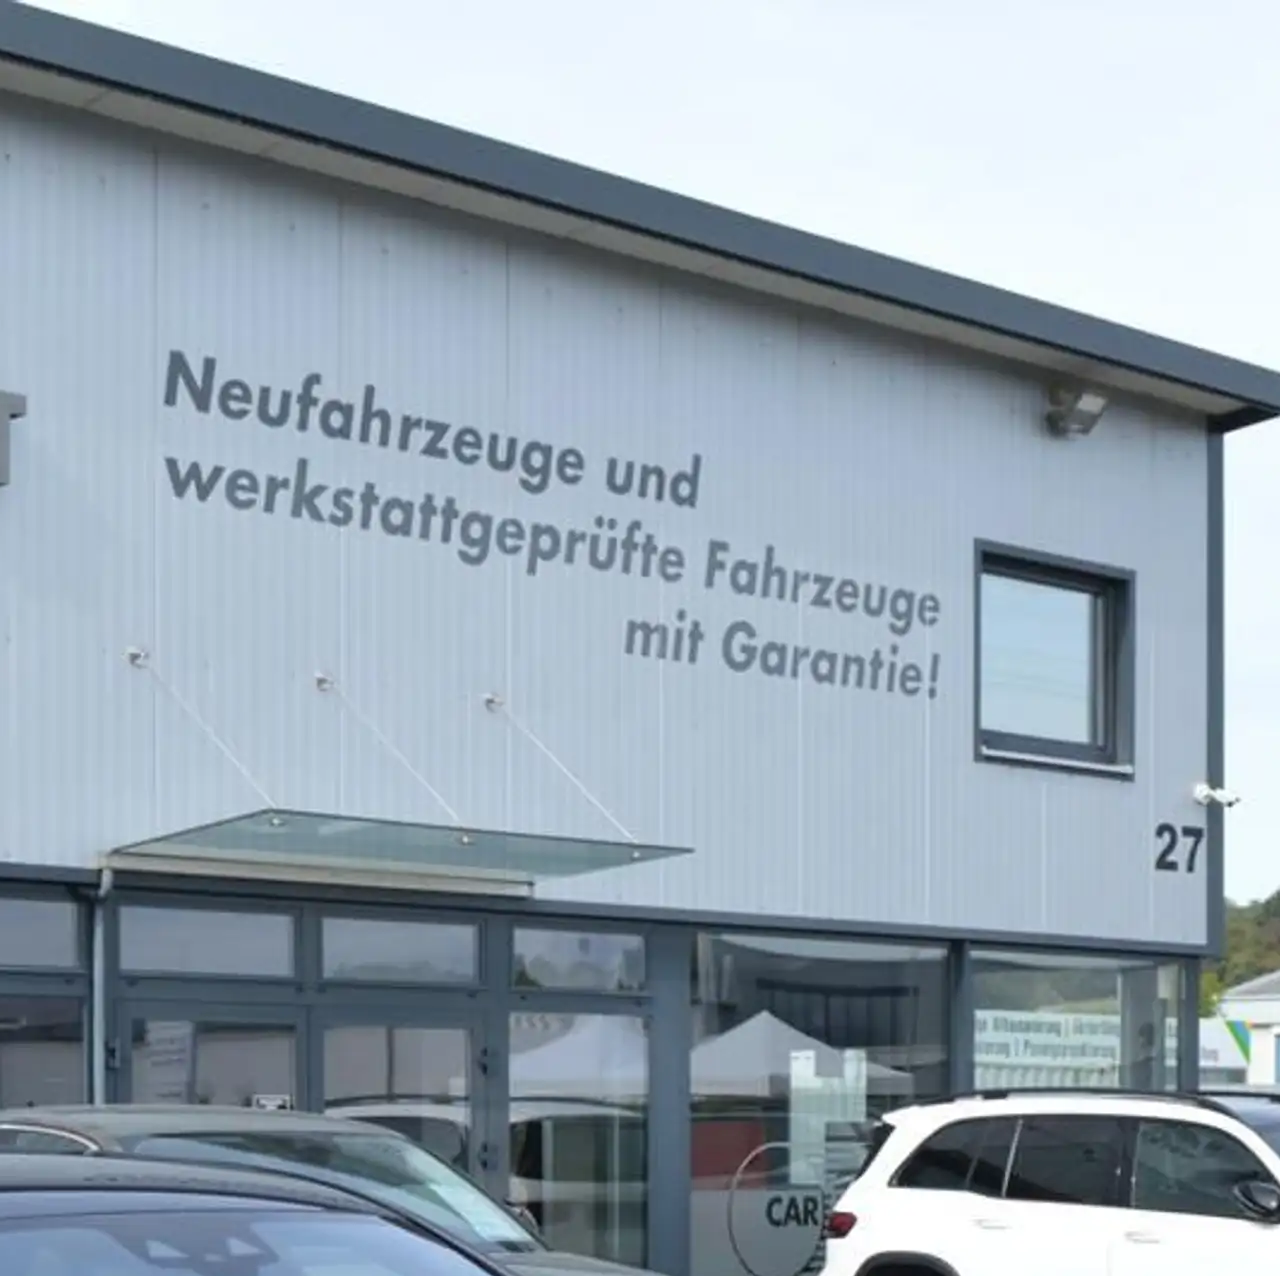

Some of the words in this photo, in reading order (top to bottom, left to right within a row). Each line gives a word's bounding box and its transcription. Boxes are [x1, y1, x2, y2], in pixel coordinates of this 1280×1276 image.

[164, 350, 586, 495] Neufahrzeuge
[606, 454, 702, 508] und
[164, 456, 685, 584] werkstattgeprüfte
[705, 540, 942, 636] Fahrzeuge
[624, 612, 704, 665] mit
[721, 620, 942, 700] Garantie!
[1154, 823, 1205, 873] 27
[766, 1196, 819, 1227] CAR
